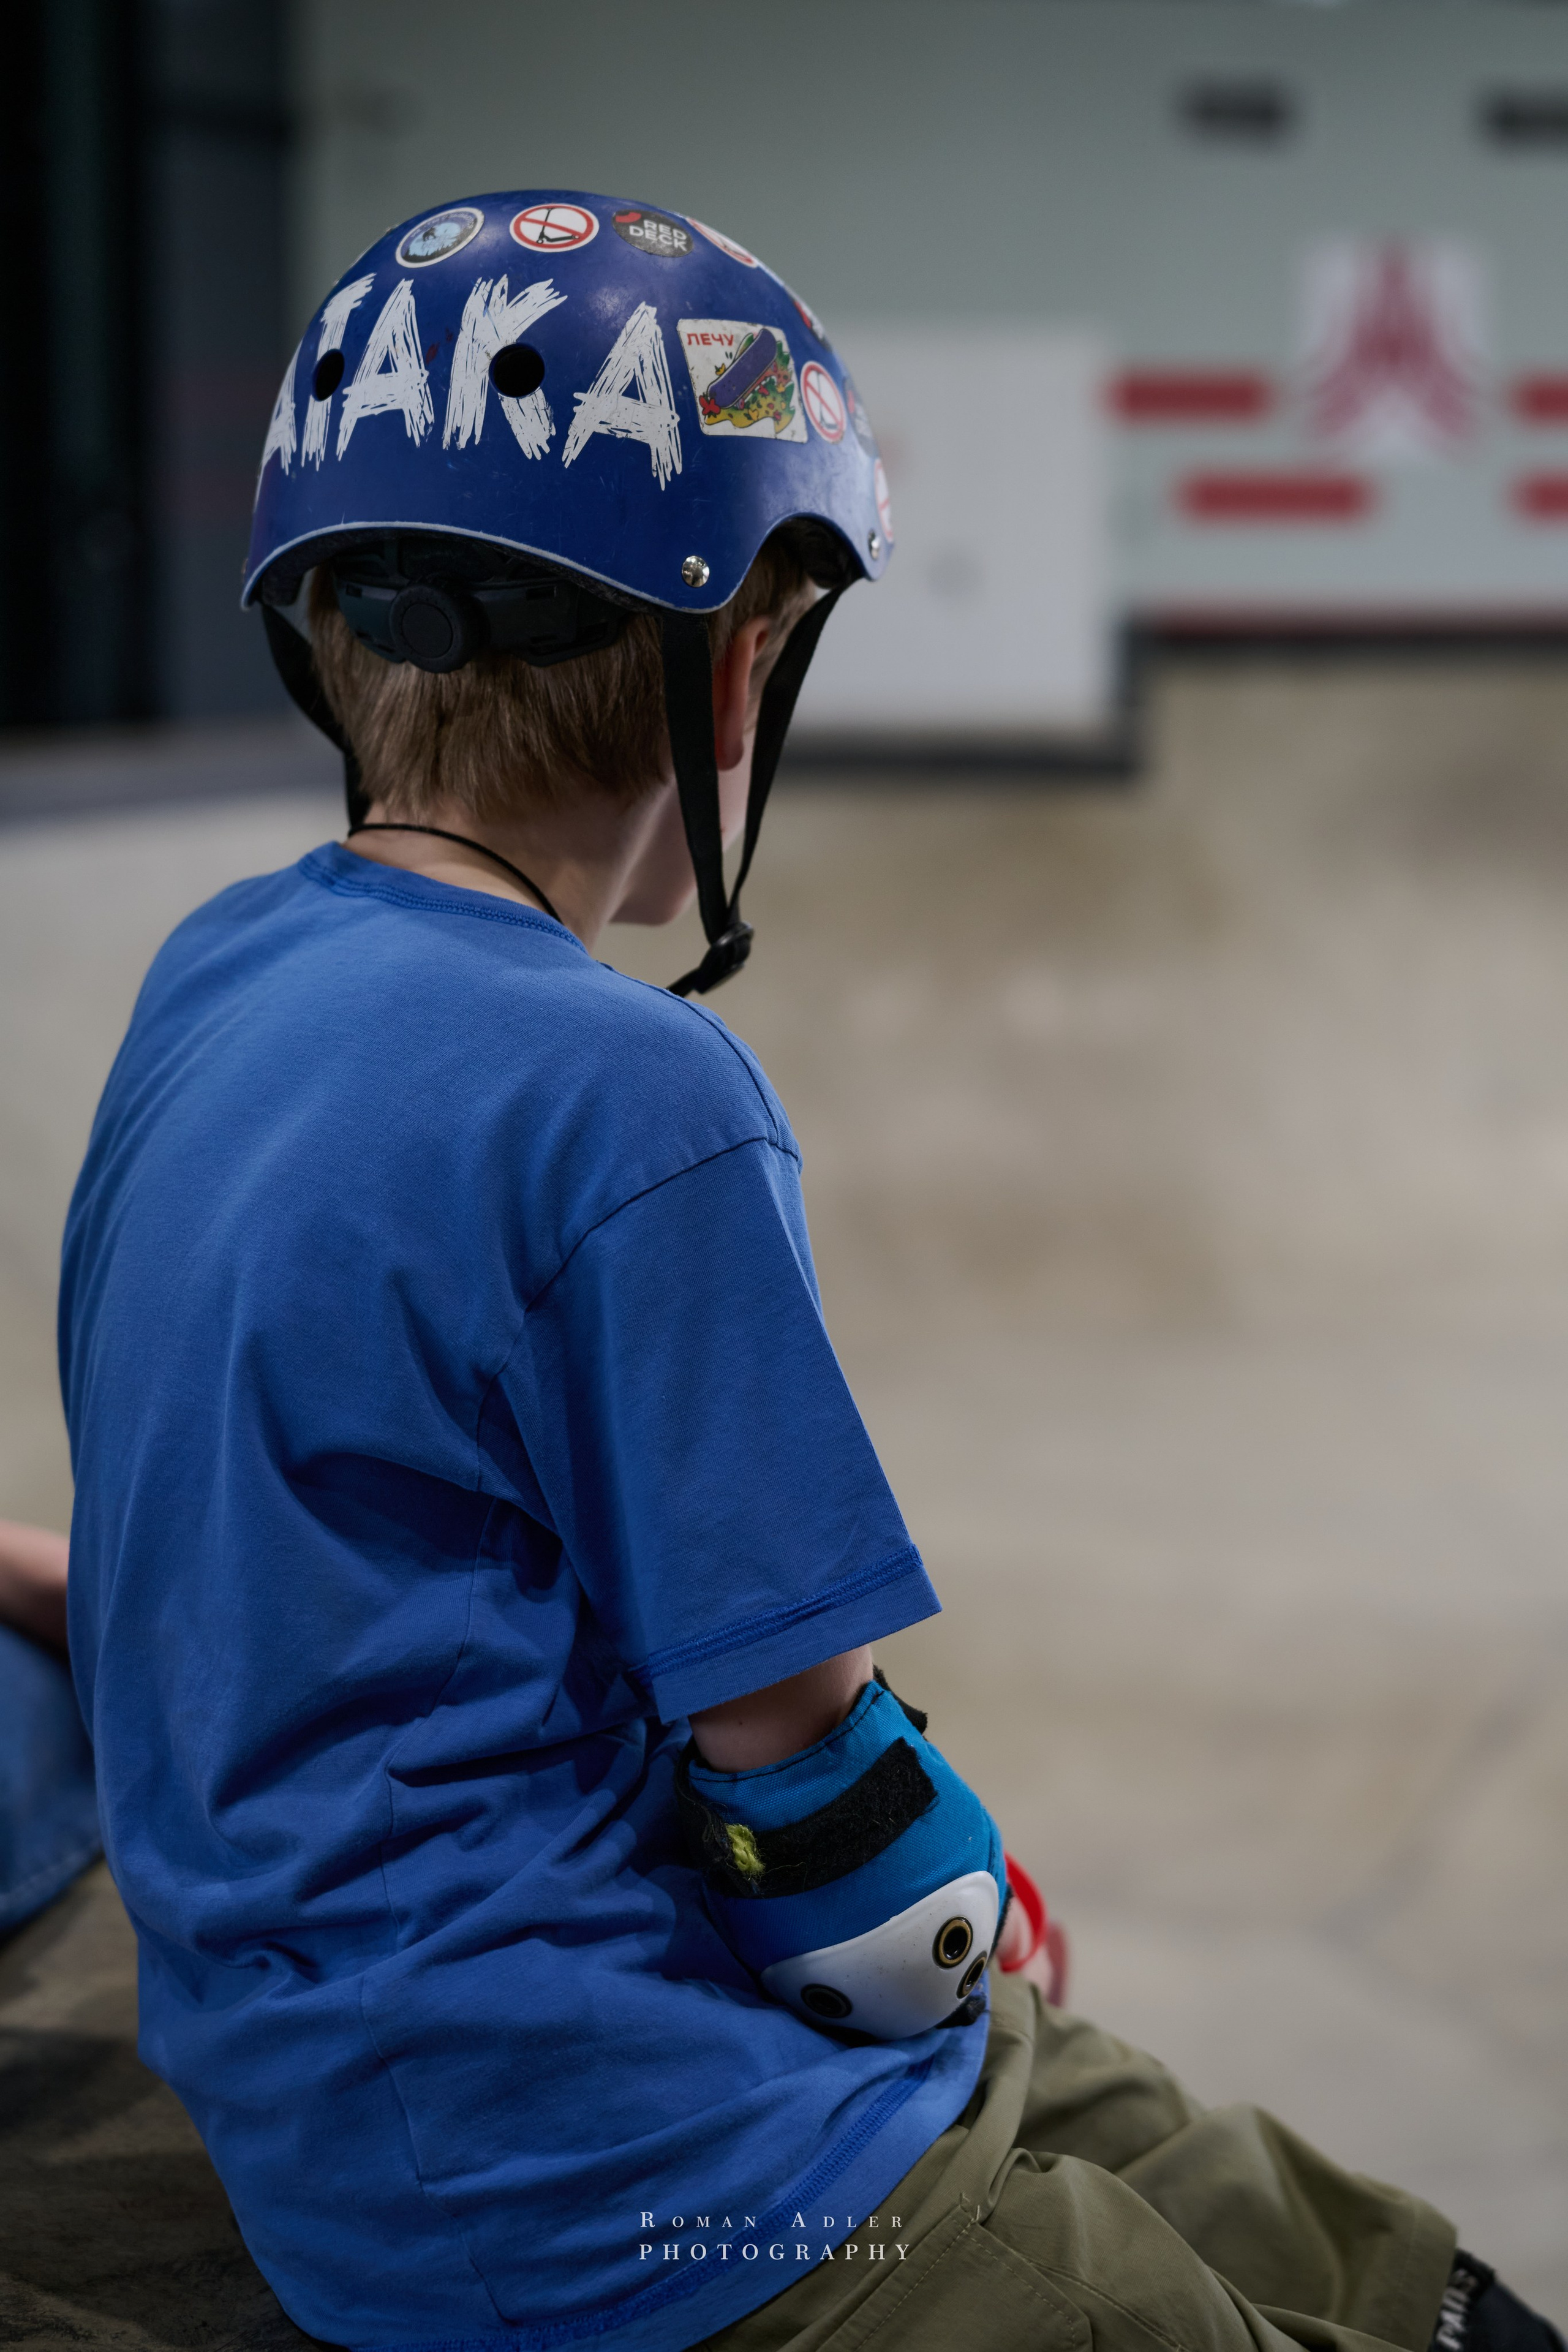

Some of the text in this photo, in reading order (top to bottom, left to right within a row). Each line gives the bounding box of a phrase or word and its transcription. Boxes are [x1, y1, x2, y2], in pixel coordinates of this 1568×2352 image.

[629, 225, 687, 252] DECK
[643, 219, 687, 240] RED
[687, 333, 734, 346] ЛЕЧУ
